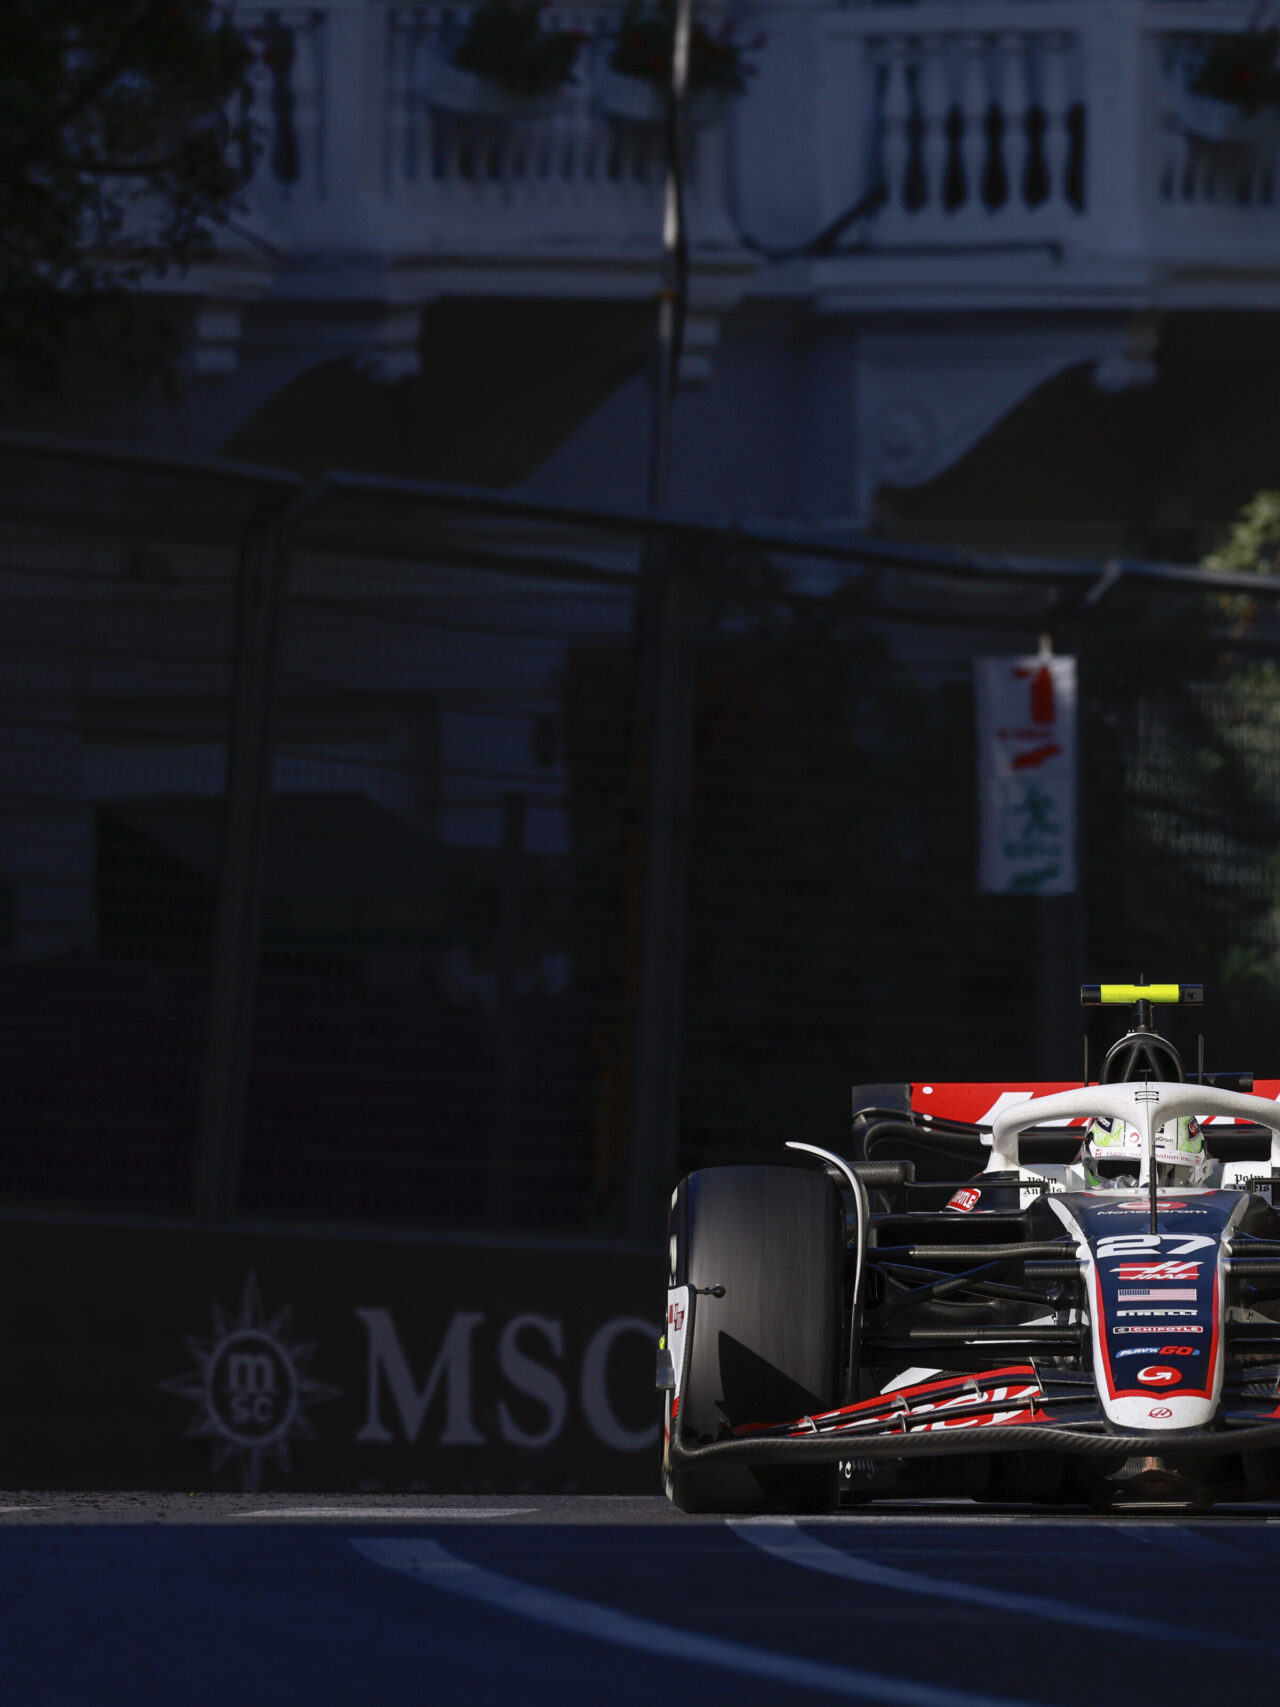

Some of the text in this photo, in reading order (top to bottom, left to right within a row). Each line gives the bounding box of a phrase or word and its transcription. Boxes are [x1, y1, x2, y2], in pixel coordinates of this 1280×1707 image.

[1096, 1234, 1217, 1259] 27
[1116, 1309, 1198, 1317] PIRELLI
[355, 1307, 662, 1452] MSC
